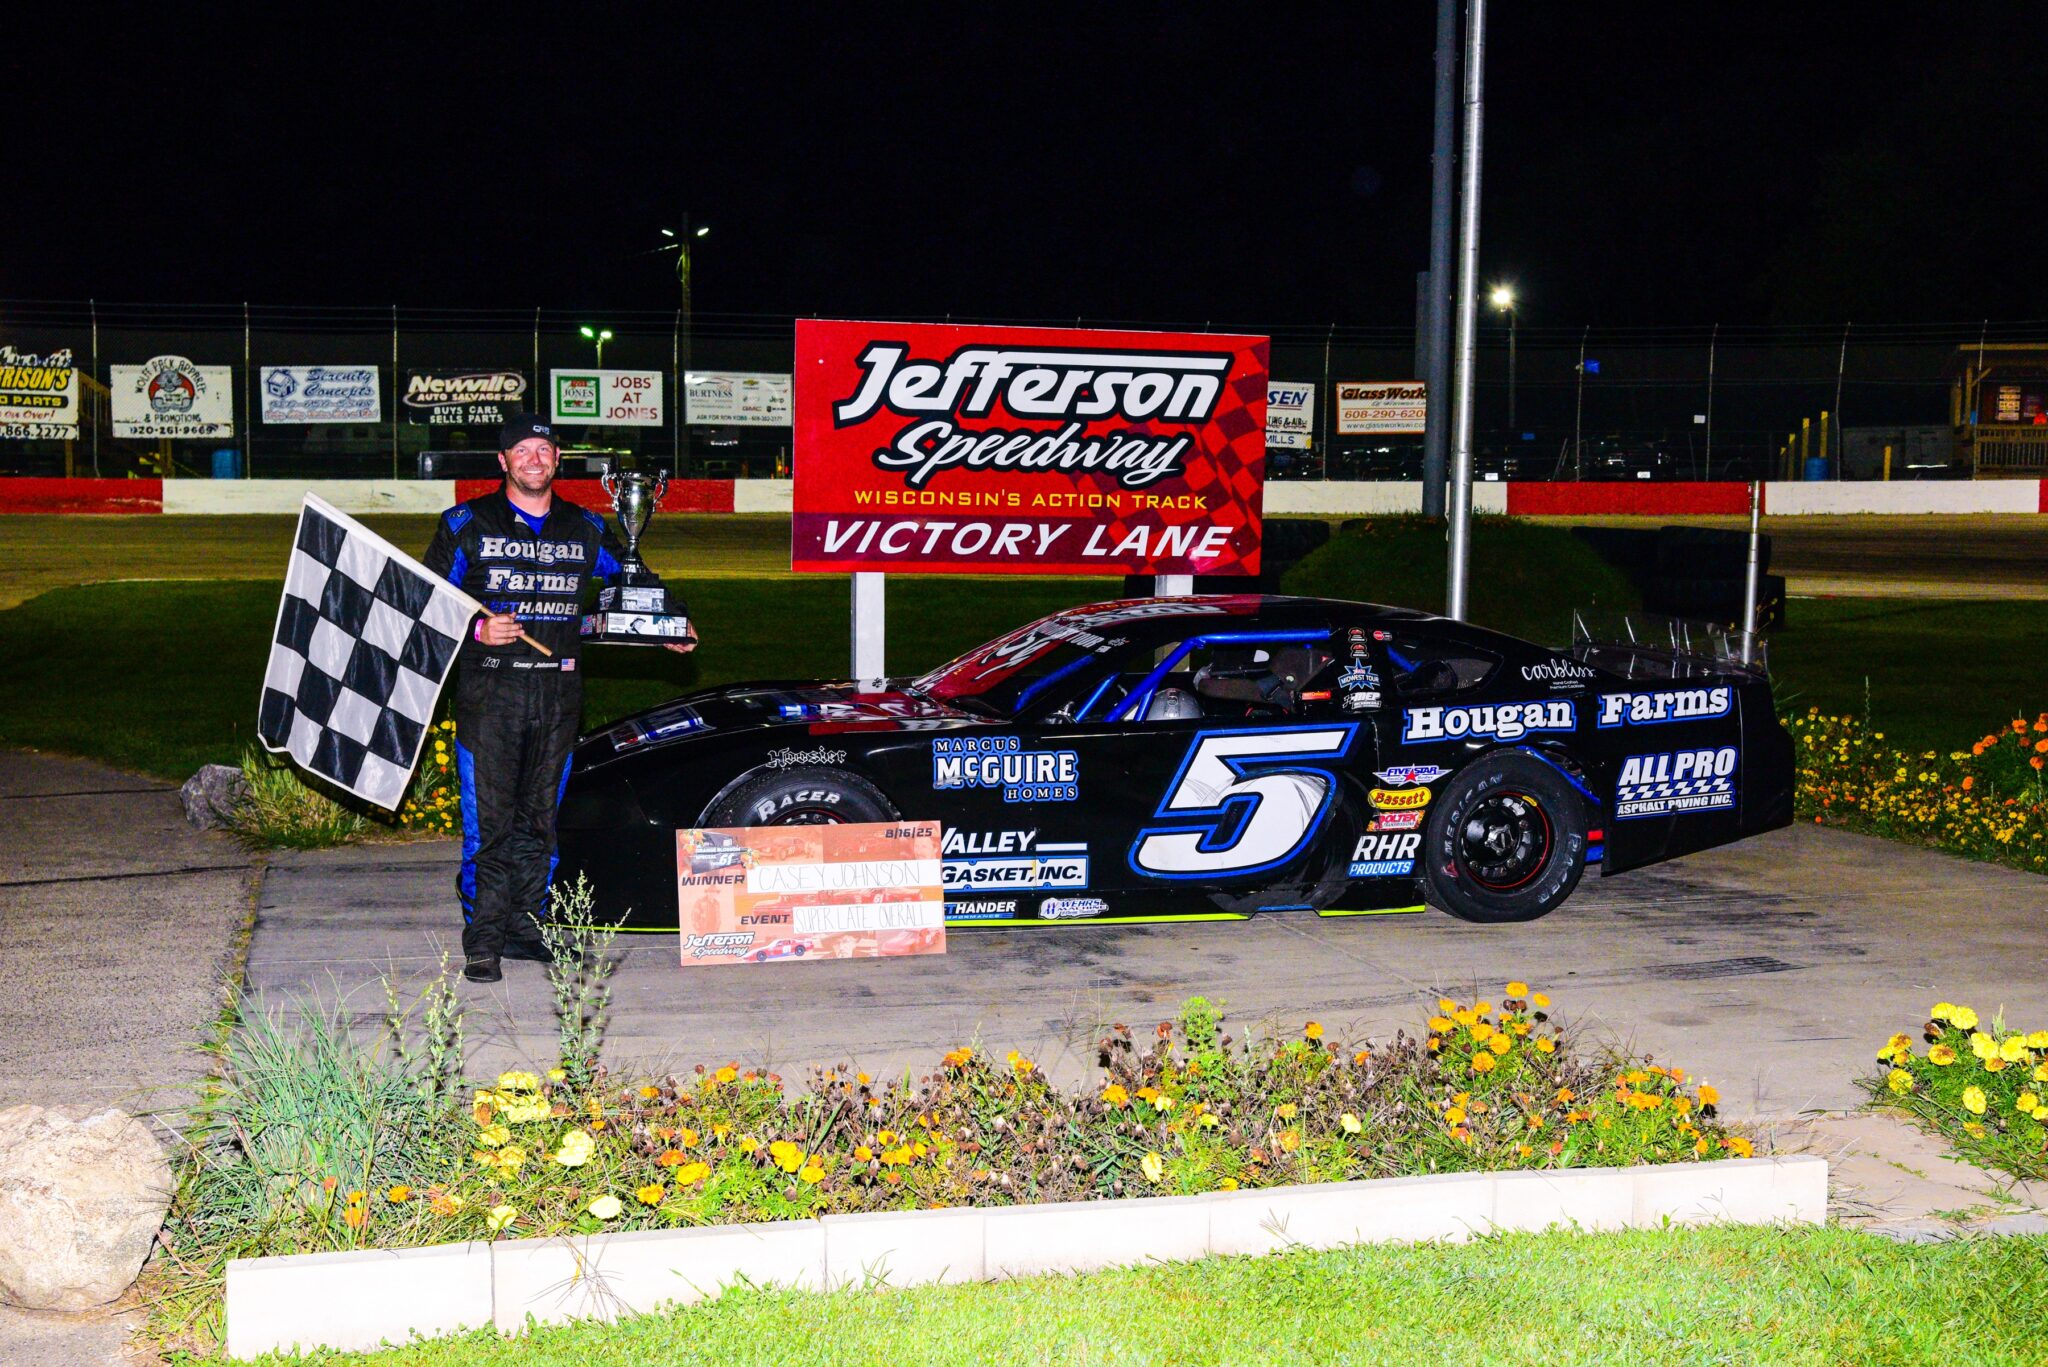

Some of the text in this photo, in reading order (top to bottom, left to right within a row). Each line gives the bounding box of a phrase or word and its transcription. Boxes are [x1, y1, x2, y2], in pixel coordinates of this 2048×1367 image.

[306, 368, 374, 384] Serenity
[408, 375, 519, 393] Newville
[612, 376, 652, 389] JOBS
[836, 345, 1230, 421] Jefferson
[303, 383, 375, 399] Concepts
[416, 393, 448, 401] AUTO
[451, 393, 502, 401] SALVAGE
[563, 388, 594, 398] JONES
[621, 392, 642, 404] AT
[689, 389, 733, 398] BURTNESS
[13, 395, 62, 407] PARTS
[433, 405, 499, 415] BUYS CARS
[606, 407, 658, 420] JONES
[1344, 409, 1427, 419] 608-290-620
[429, 414, 504, 424] SELLS PARTS
[1345, 422, 1426, 430] www.glassworkswi.co
[876, 420, 1190, 486] Speedway
[854, 489, 1208, 511] WISCONSIN'S ACTION TRACK
[822, 519, 1235, 558] VICTORY LANE
[479, 536, 586, 563] Hougan
[485, 568, 580, 593] Farms
[1406, 687, 1729, 739] Hougan Farms
[936, 739, 1018, 752] MARCUS
[765, 745, 847, 768] Hoosier
[1387, 766, 1438, 777] FIVE STAR
[1618, 748, 1736, 787] ALL PRO
[1006, 786, 1077, 799] HOMES
[1375, 791, 1426, 806] Bassett
[757, 789, 841, 822] RACER
[1133, 727, 1353, 876] 5
[1617, 794, 1732, 815] ASPHALT PAVING INC.
[885, 827, 933, 839] 8/16/25
[1353, 833, 1422, 861] RHR
[942, 864, 1082, 884] GASKET, INC.
[1350, 860, 1412, 876] PRODUCTS
[681, 874, 746, 886] WINNER
[758, 862, 921, 891] CASEY JOHNSON
[1061, 899, 1100, 908] WEHRS
[741, 913, 790, 925] EVENT
[795, 907, 833, 933] SUPER
[837, 905, 873, 930] LATE
[684, 932, 755, 949] Jefferson
[691, 946, 749, 960] Speedway
